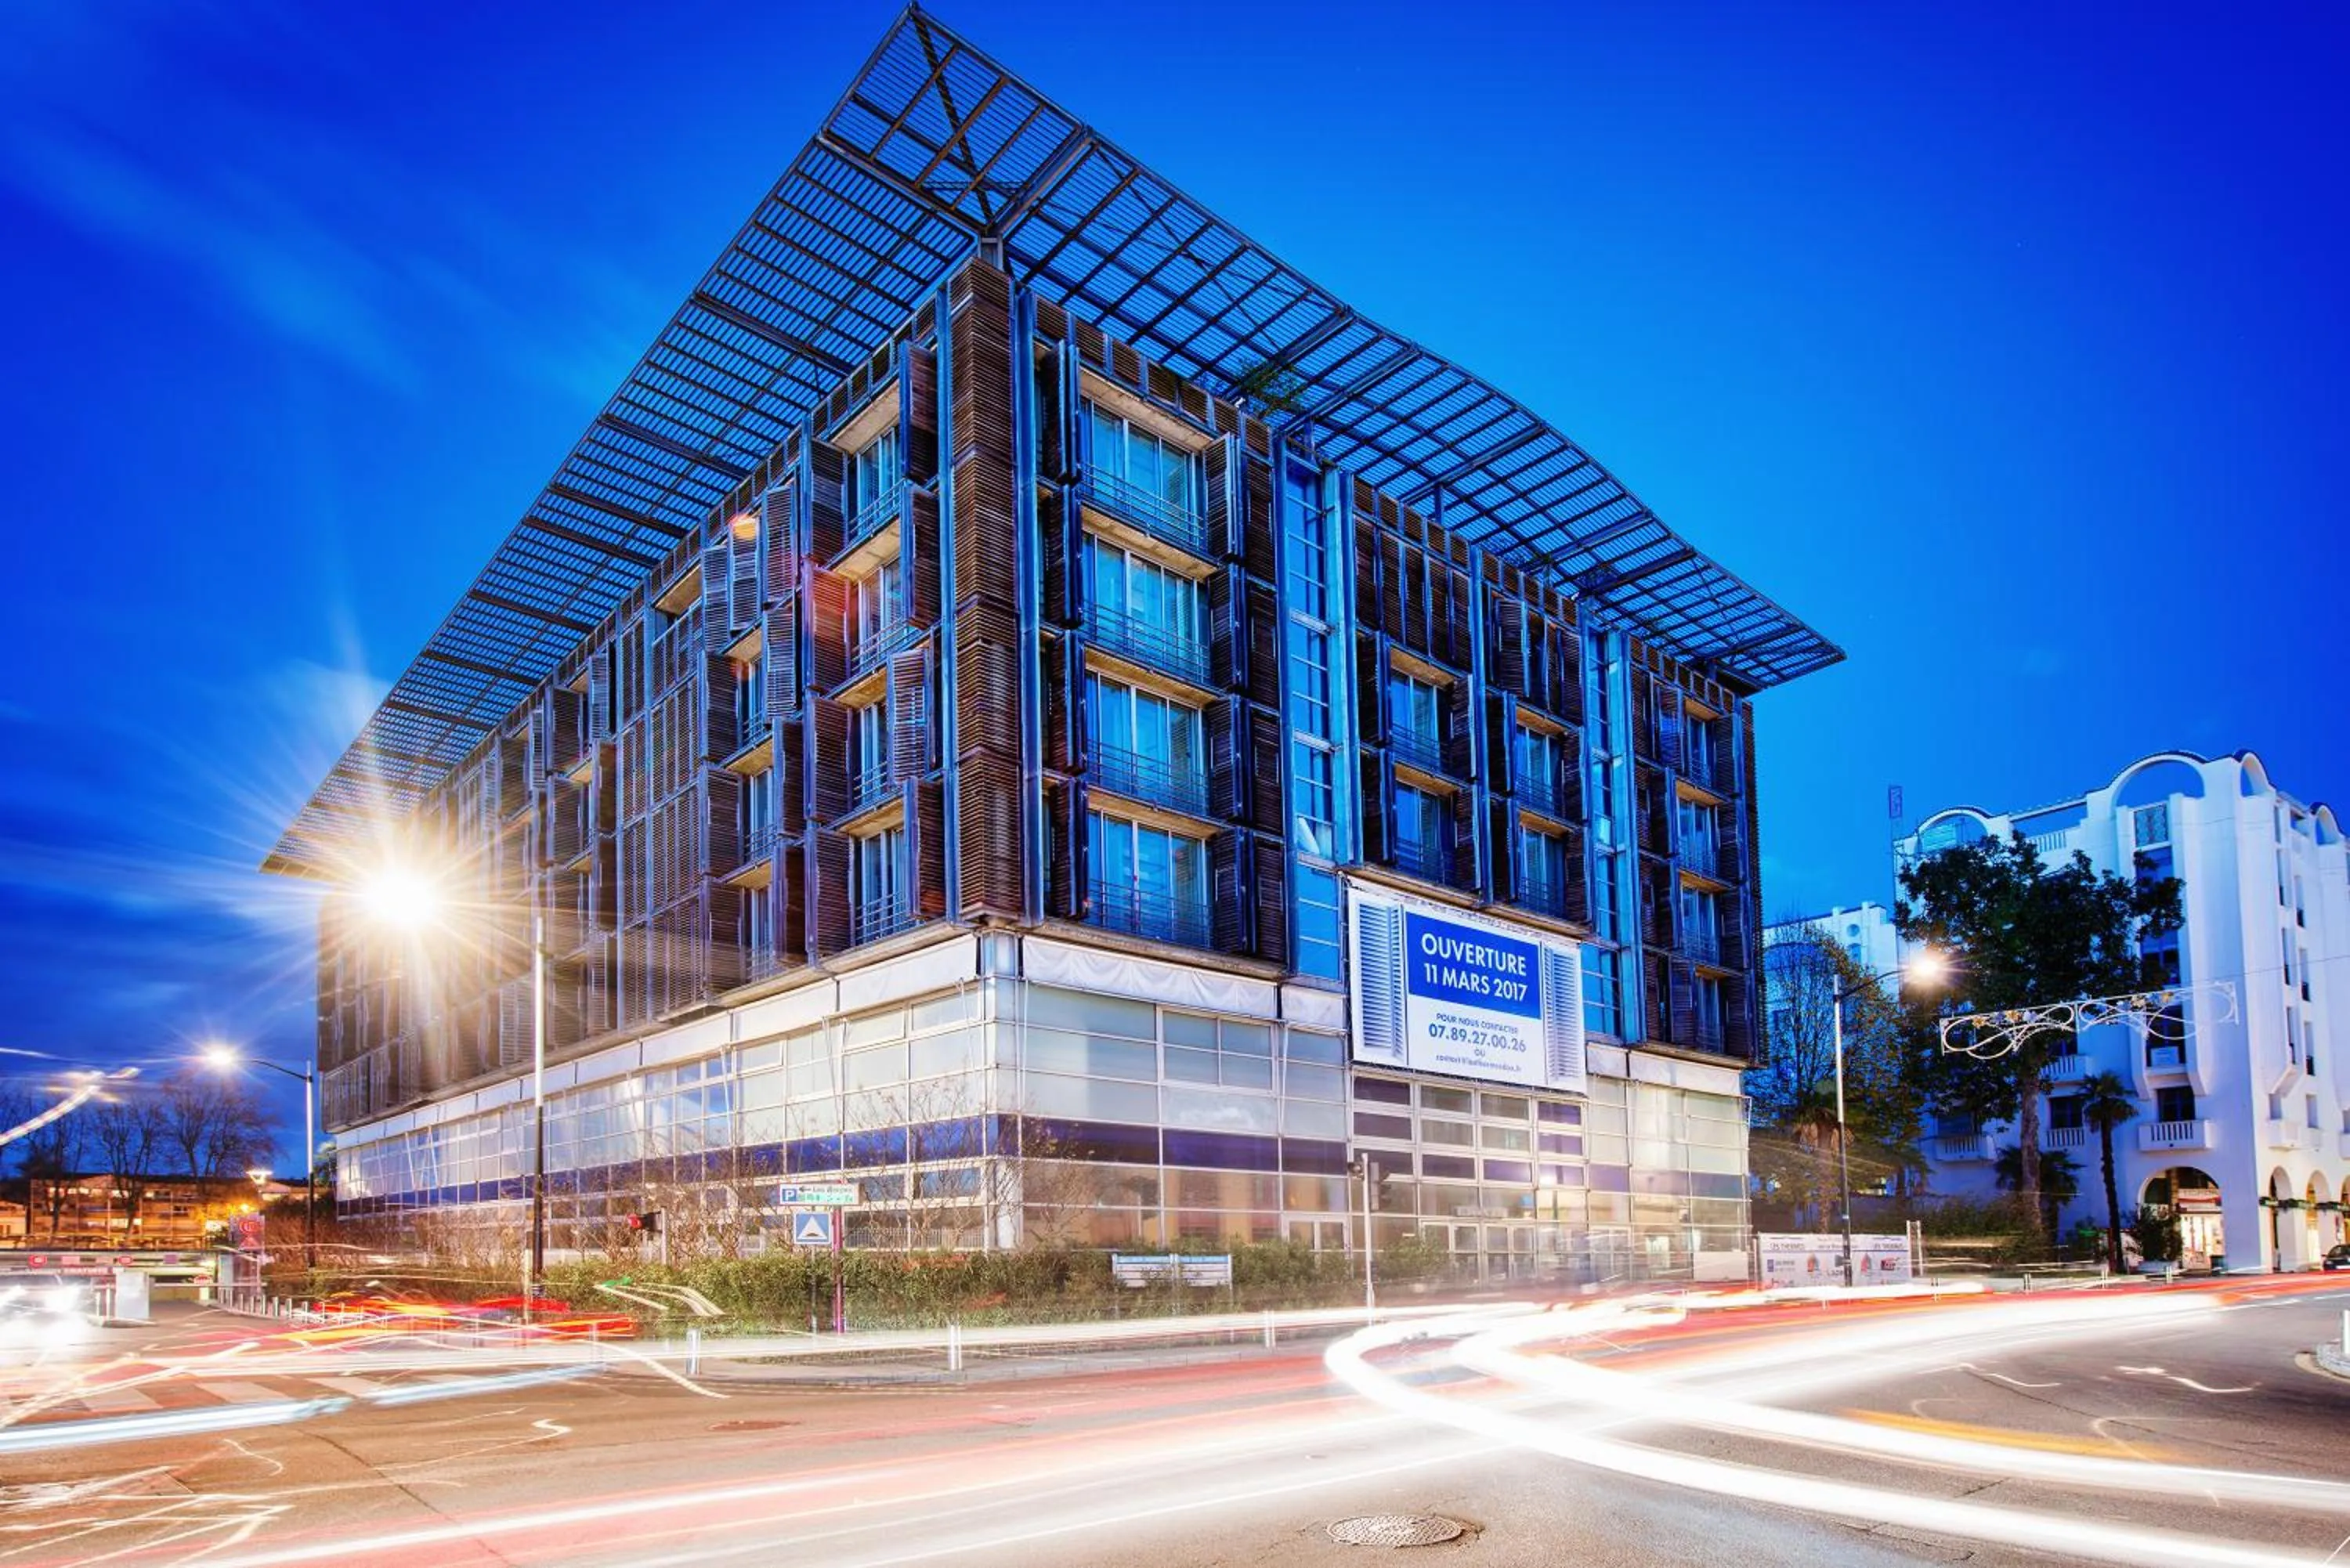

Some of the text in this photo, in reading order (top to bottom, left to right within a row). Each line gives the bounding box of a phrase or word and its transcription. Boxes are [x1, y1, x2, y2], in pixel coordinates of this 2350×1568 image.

[1422, 933, 1527, 976] OUVERTURE
[1424, 963, 1528, 1001] 11 MARS 2017
[1429, 1023, 1526, 1052] 07.89.27.00.26
[1436, 1013, 1518, 1034] POUR NOUS CONTACTER
[785, 1190, 794, 1201] P
